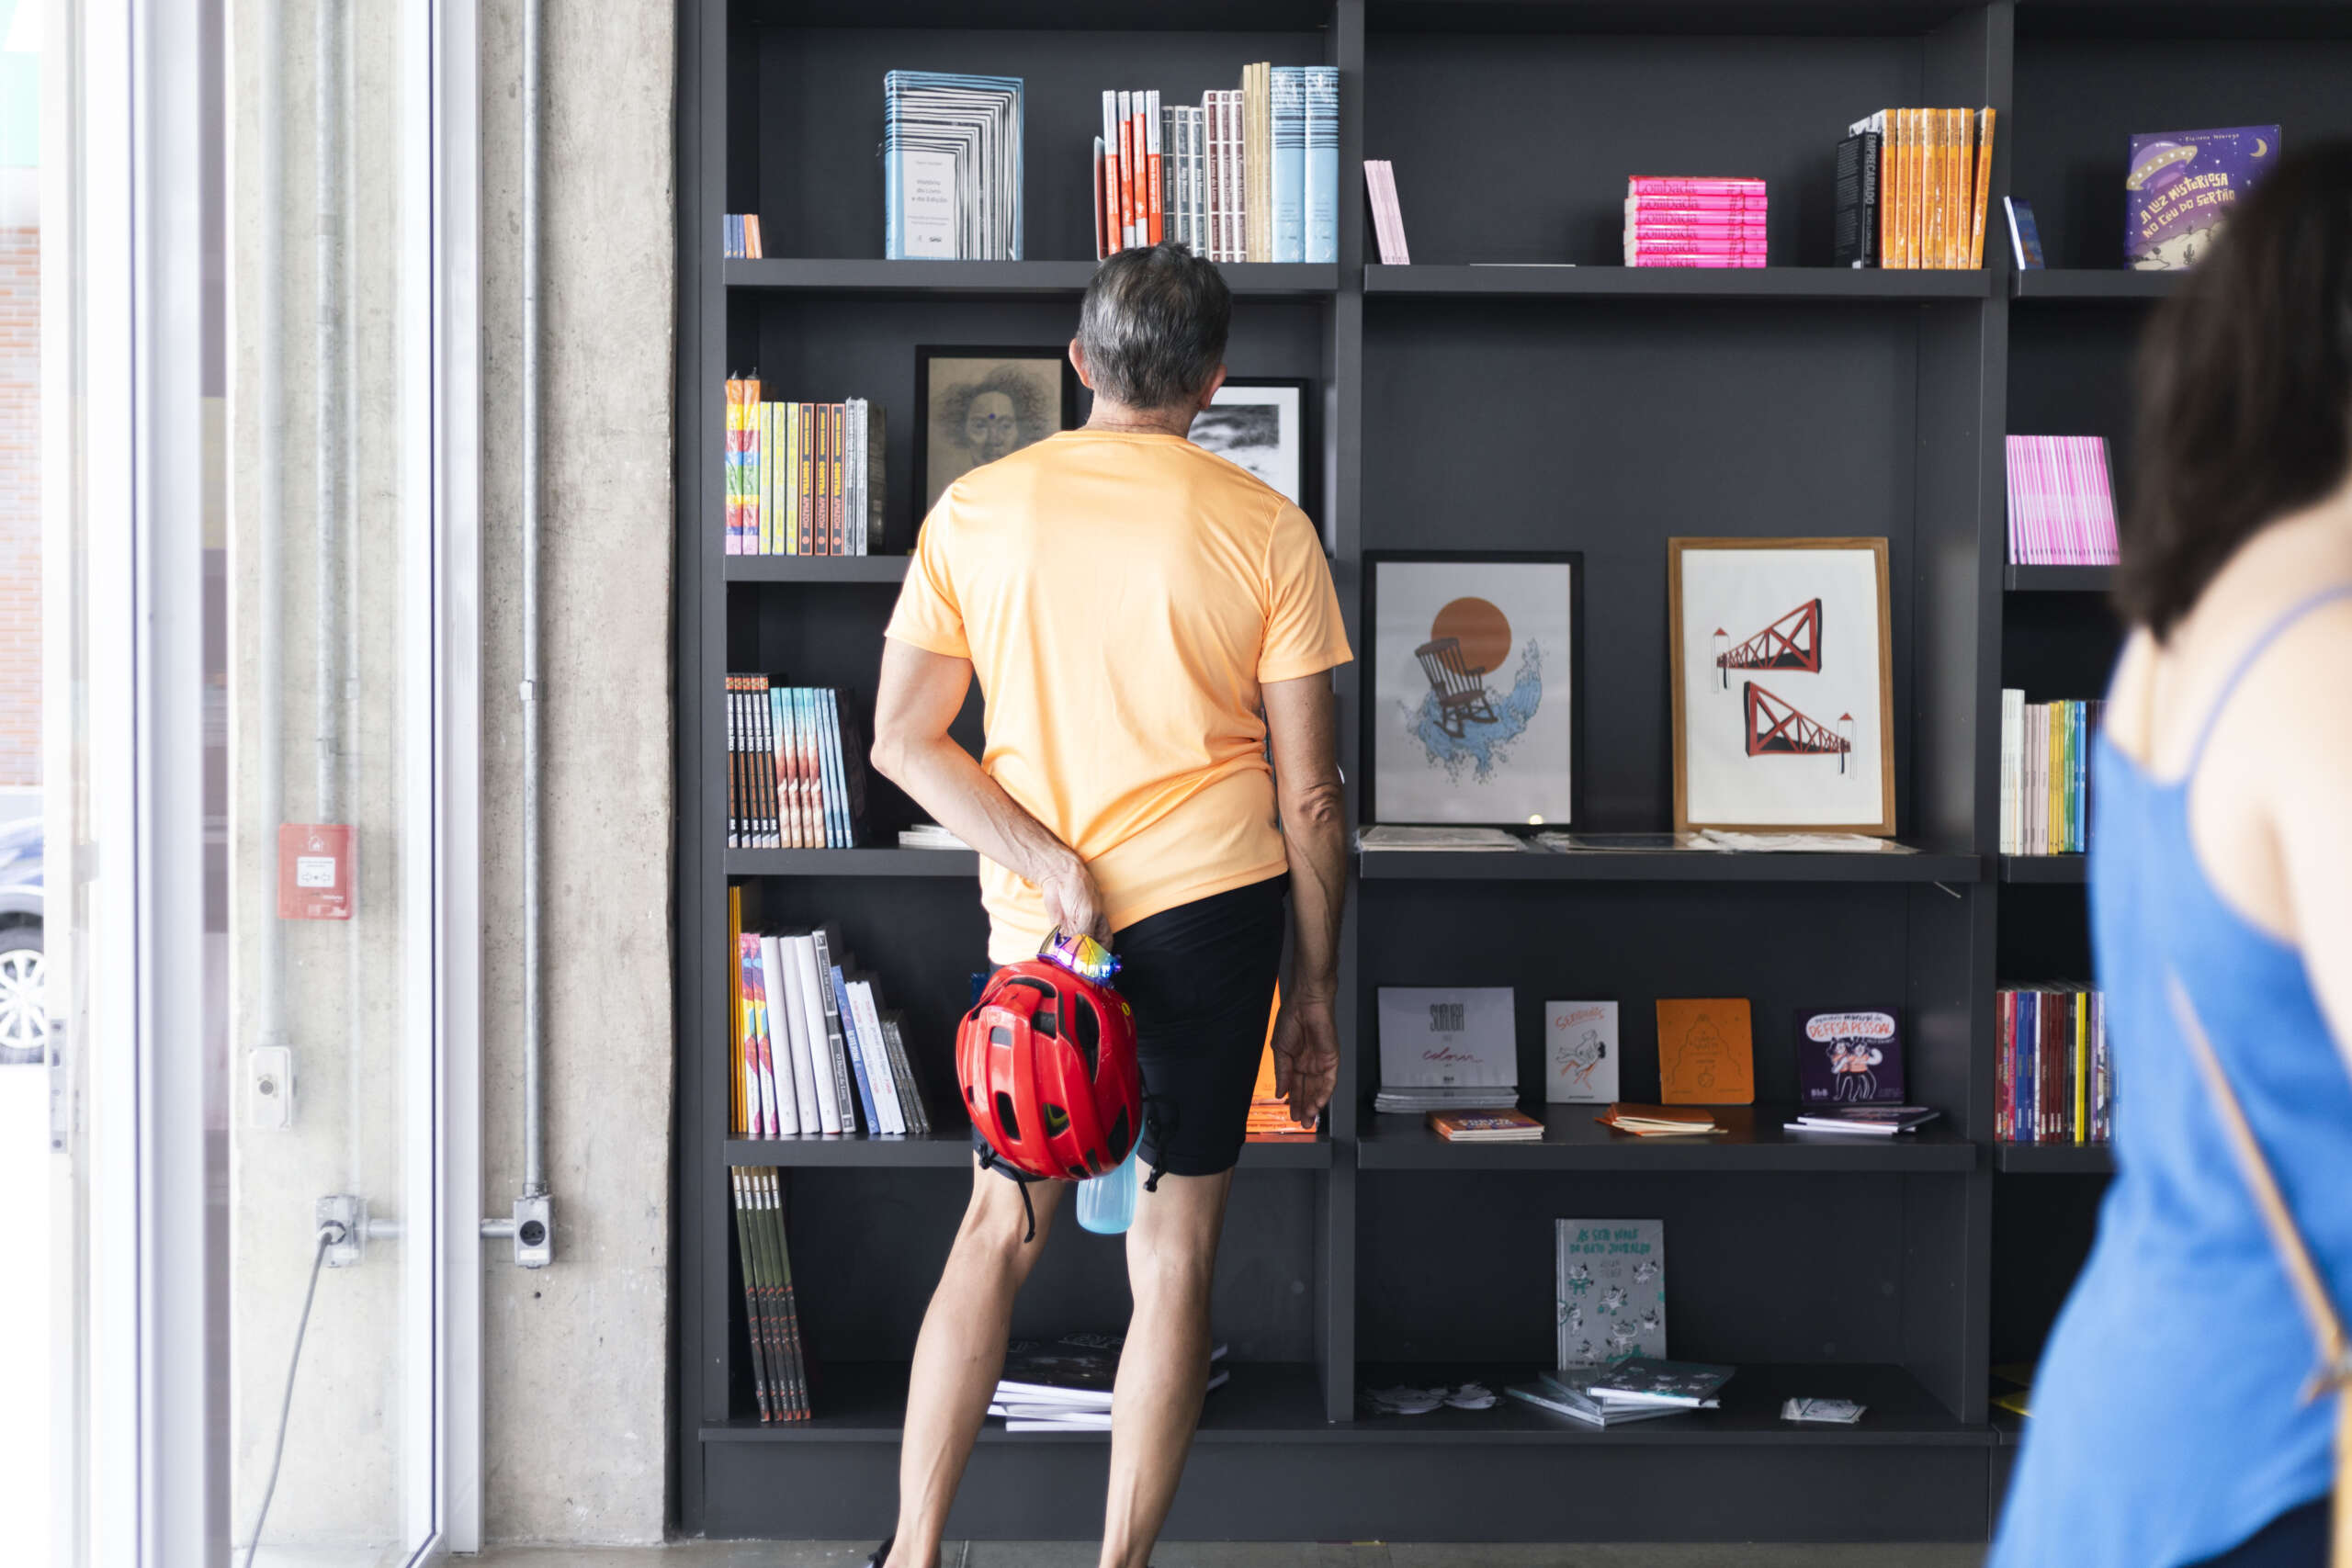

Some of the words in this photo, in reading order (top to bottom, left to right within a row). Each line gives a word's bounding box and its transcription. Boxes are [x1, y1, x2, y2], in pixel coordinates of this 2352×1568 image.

[1865, 134, 1876, 204] EMPRECARIADO
[2141, 209, 2152, 225] A
[2148, 195, 2169, 214] LUZ
[2168, 172, 2229, 201] MISTERIOSA
[2142, 221, 2159, 239] NO
[2178, 199, 2194, 213] DO
[2196, 188, 2235, 207] SERTÃO
[1808, 1021, 1849, 1038] DEFESA
[1851, 1021, 1892, 1035] PESSOAL
